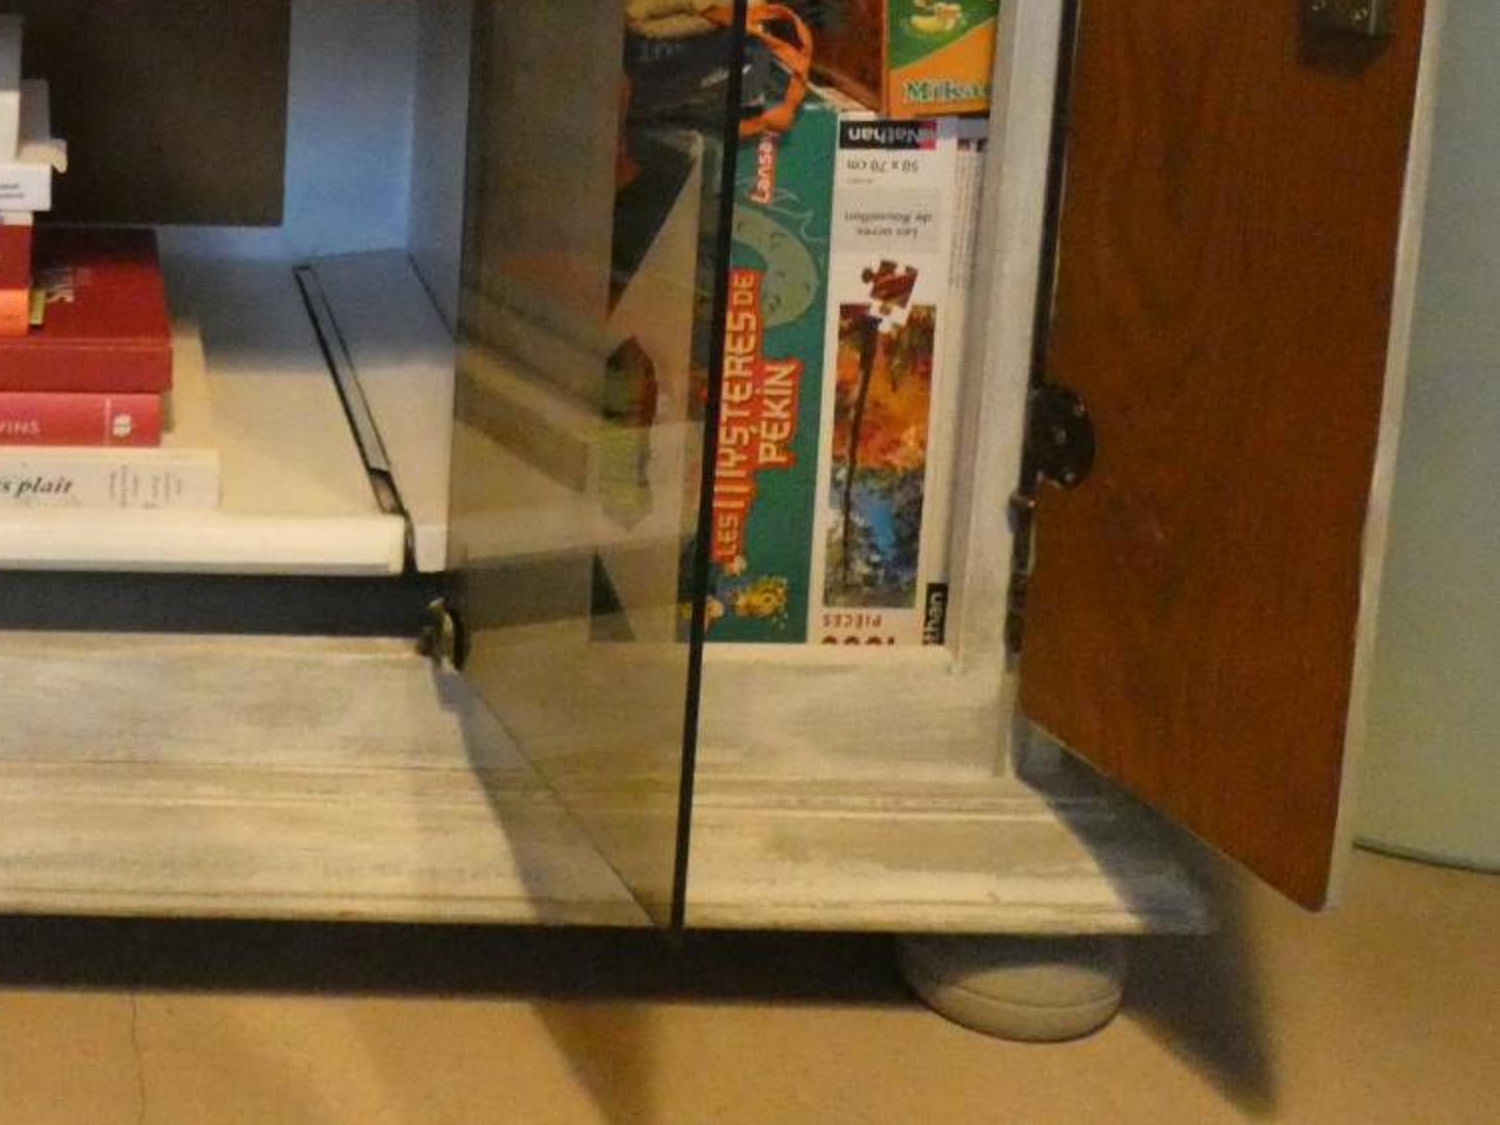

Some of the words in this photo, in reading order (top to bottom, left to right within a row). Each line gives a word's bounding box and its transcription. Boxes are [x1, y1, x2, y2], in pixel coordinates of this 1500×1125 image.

[904, 79, 985, 104] Mika
[847, 127, 918, 145] Nathan
[750, 137, 776, 205] Lansa
[846, 159, 867, 171] cm
[717, 513, 740, 560] LES
[731, 275, 756, 307] DE
